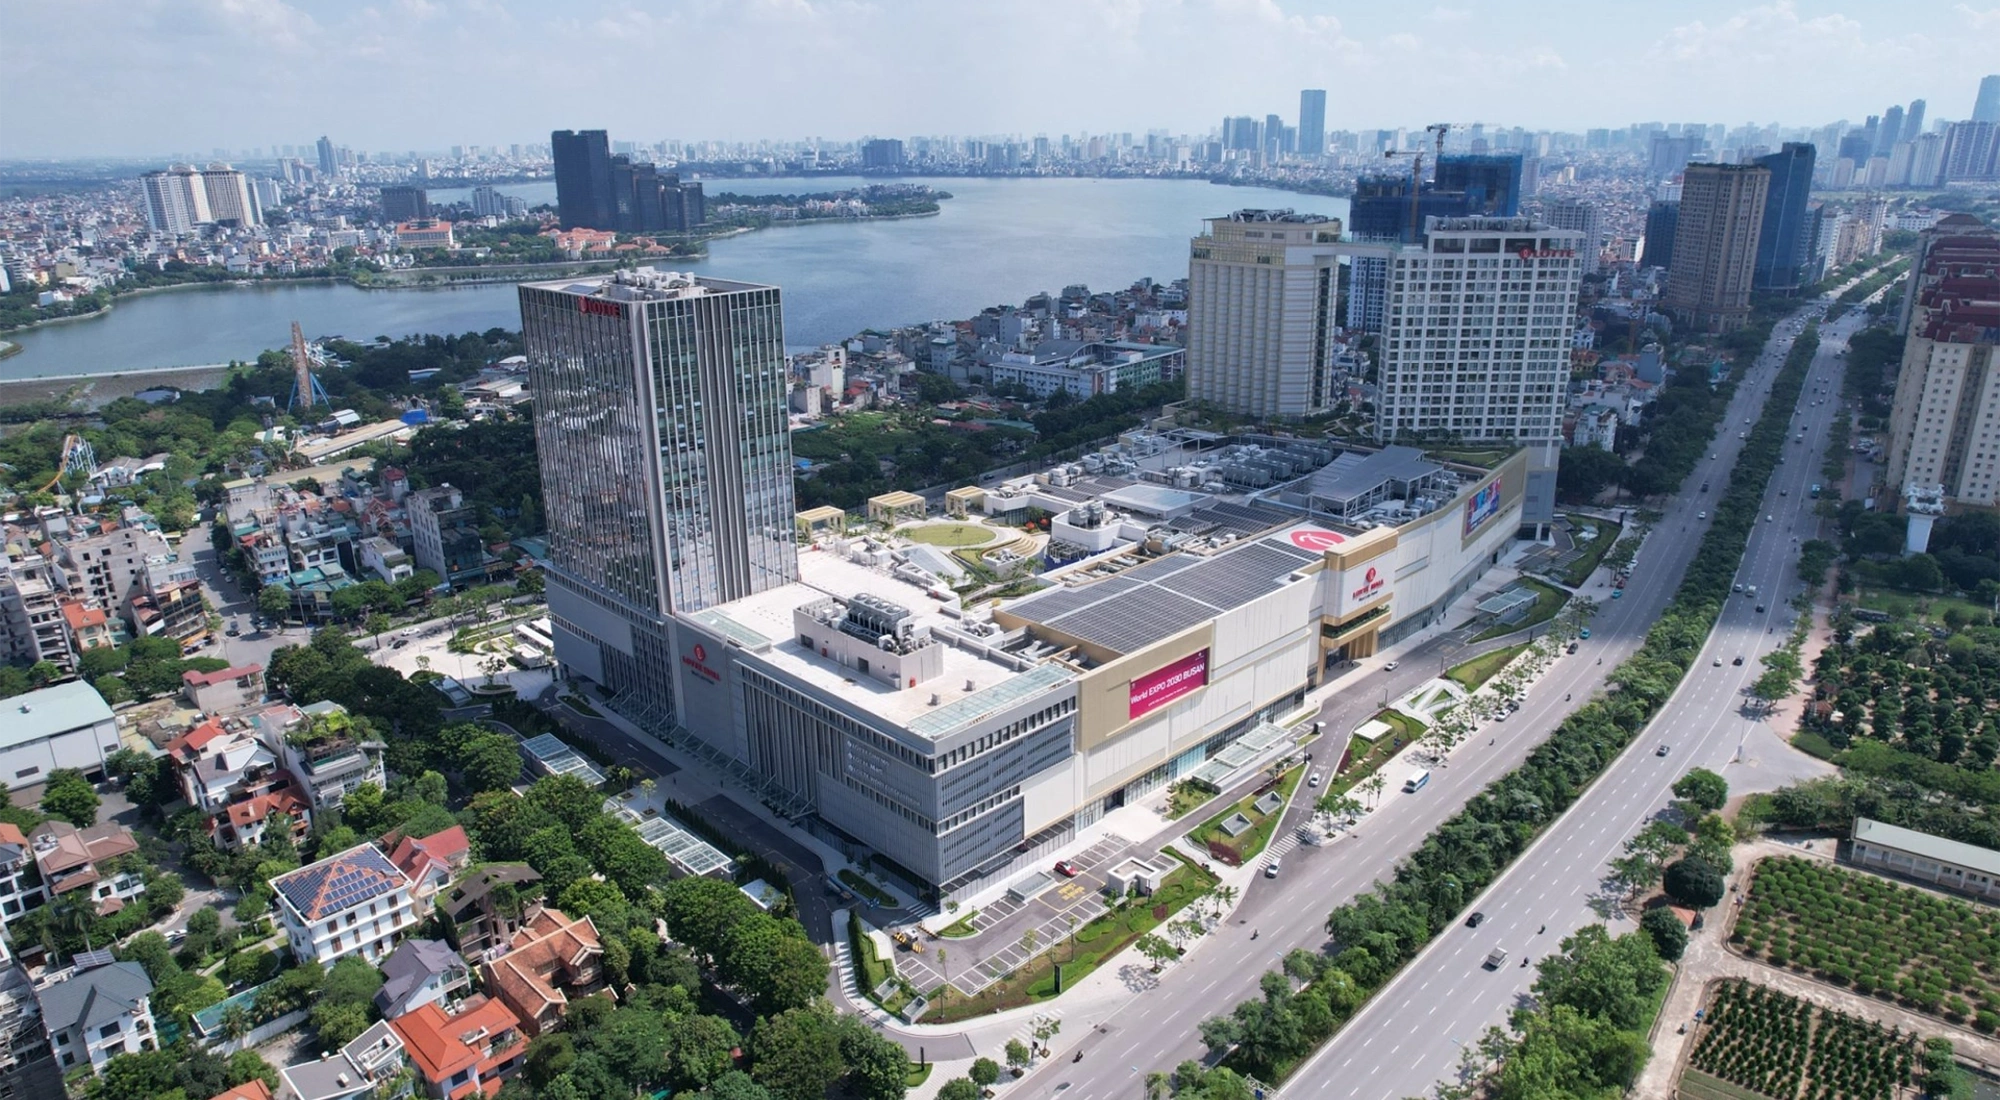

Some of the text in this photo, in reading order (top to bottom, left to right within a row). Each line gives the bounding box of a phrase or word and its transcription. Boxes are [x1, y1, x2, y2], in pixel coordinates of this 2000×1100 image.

[1533, 248, 1575, 258] LOTTE
[588, 301, 620, 317] LOTTE
[1131, 690, 1148, 704] World
[1149, 682, 1166, 696] EXPO
[1167, 674, 1183, 688] 2030
[1183, 663, 1205, 680] BUSAN
